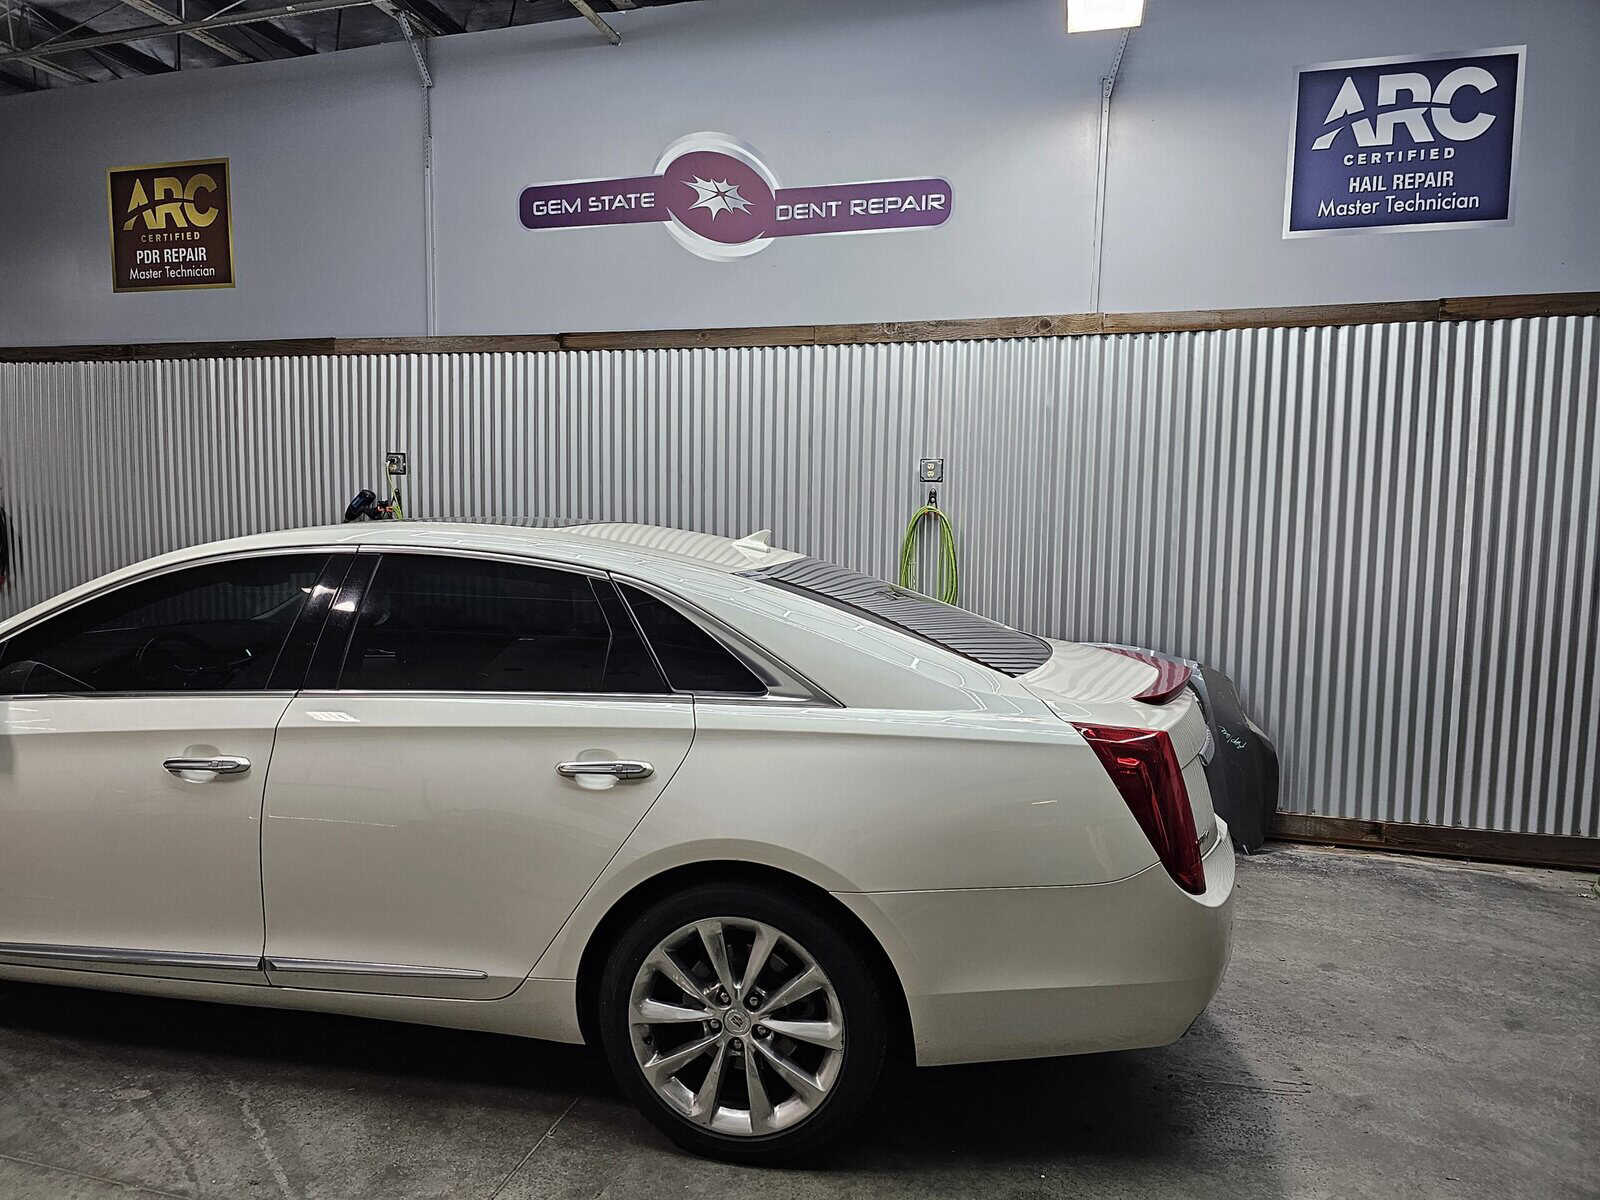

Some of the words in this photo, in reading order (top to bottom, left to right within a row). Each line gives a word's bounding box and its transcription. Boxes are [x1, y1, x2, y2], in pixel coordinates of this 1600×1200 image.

[1311, 66, 1498, 151] ARC
[1343, 147, 1456, 166] CERTIFIED
[1348, 175, 1387, 193] HAIL
[1392, 171, 1454, 190] REPAIR
[123, 173, 219, 231] ARC
[532, 196, 582, 216] GEM
[588, 192, 655, 213] STATE
[775, 200, 842, 221] DENT
[849, 193, 946, 217] REPAIR
[1317, 199, 1381, 217] Master
[1385, 193, 1480, 213] Technician
[141, 231, 200, 243] CERTIFIED
[136, 249, 160, 264] PDR
[164, 247, 207, 263] REPAIR
[129, 267, 162, 280] Master
[165, 264, 215, 278] Technician
